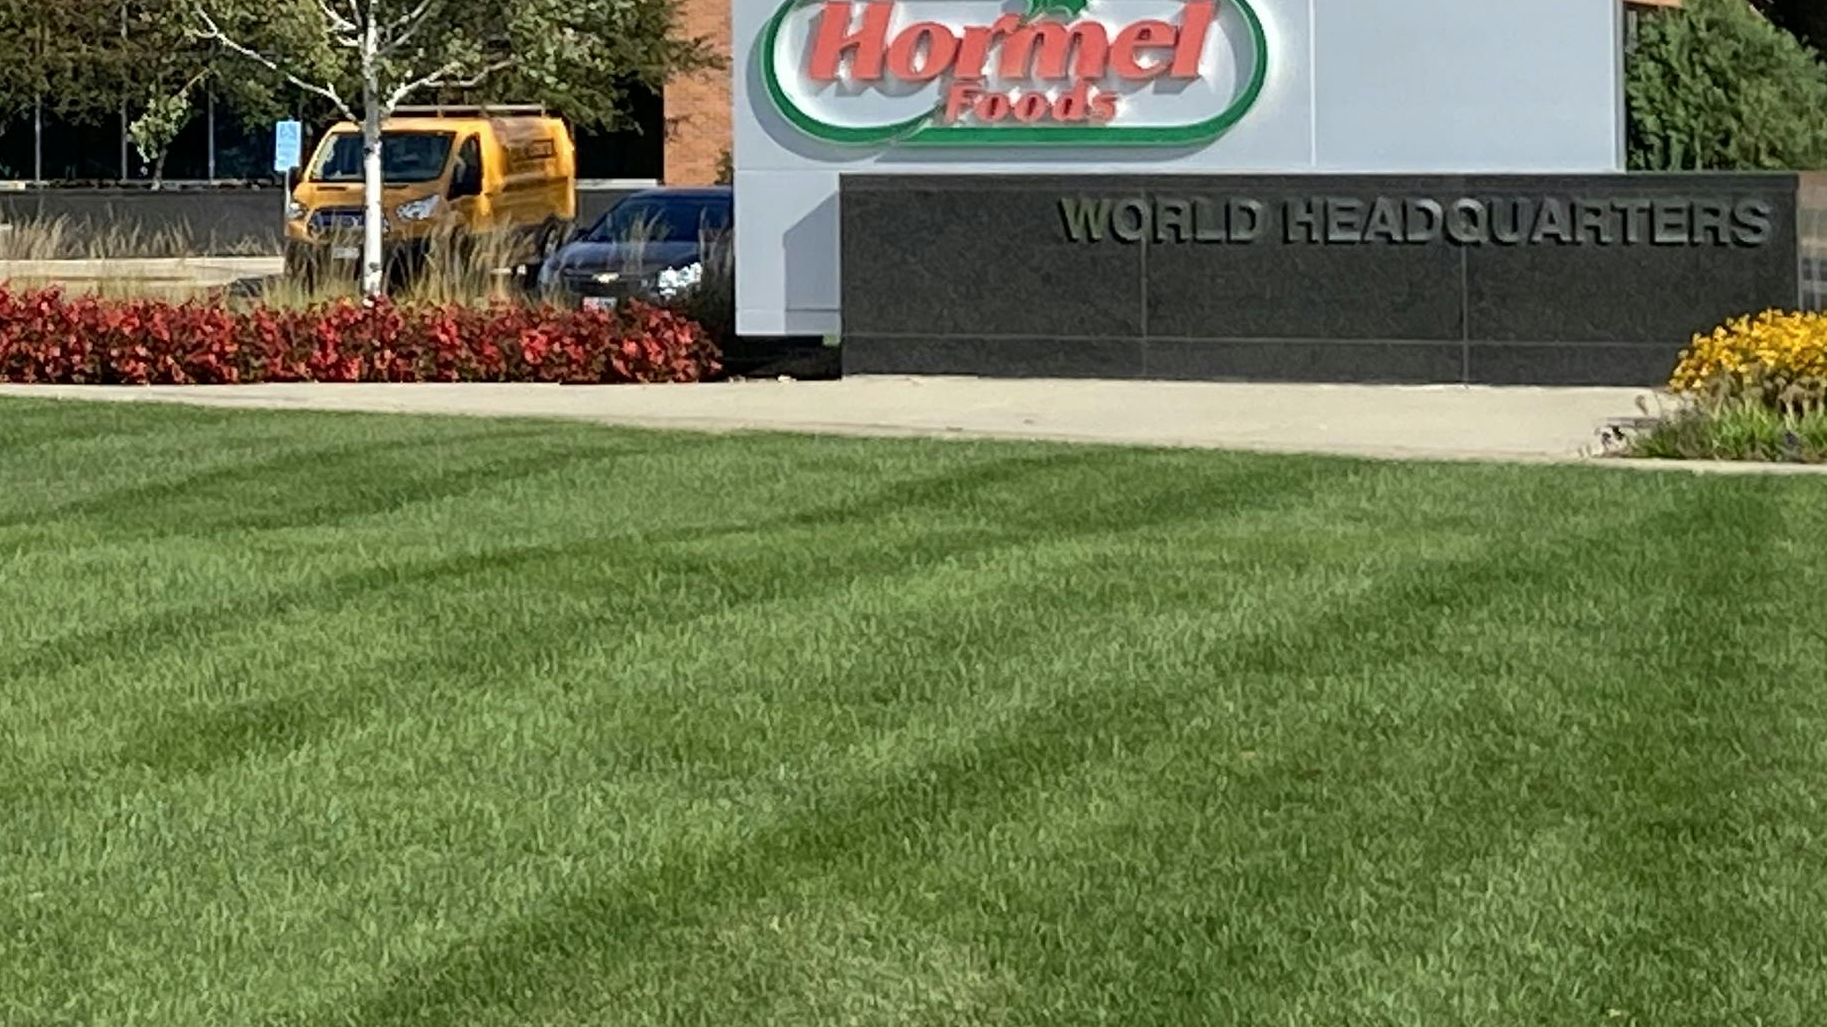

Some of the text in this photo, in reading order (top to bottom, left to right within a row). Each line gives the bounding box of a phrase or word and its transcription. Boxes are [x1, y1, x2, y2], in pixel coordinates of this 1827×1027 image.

[807, 0, 1216, 83] Hormel
[944, 82, 1118, 123] Foods
[1058, 196, 1772, 247] WORLD HEADQUARTERS
